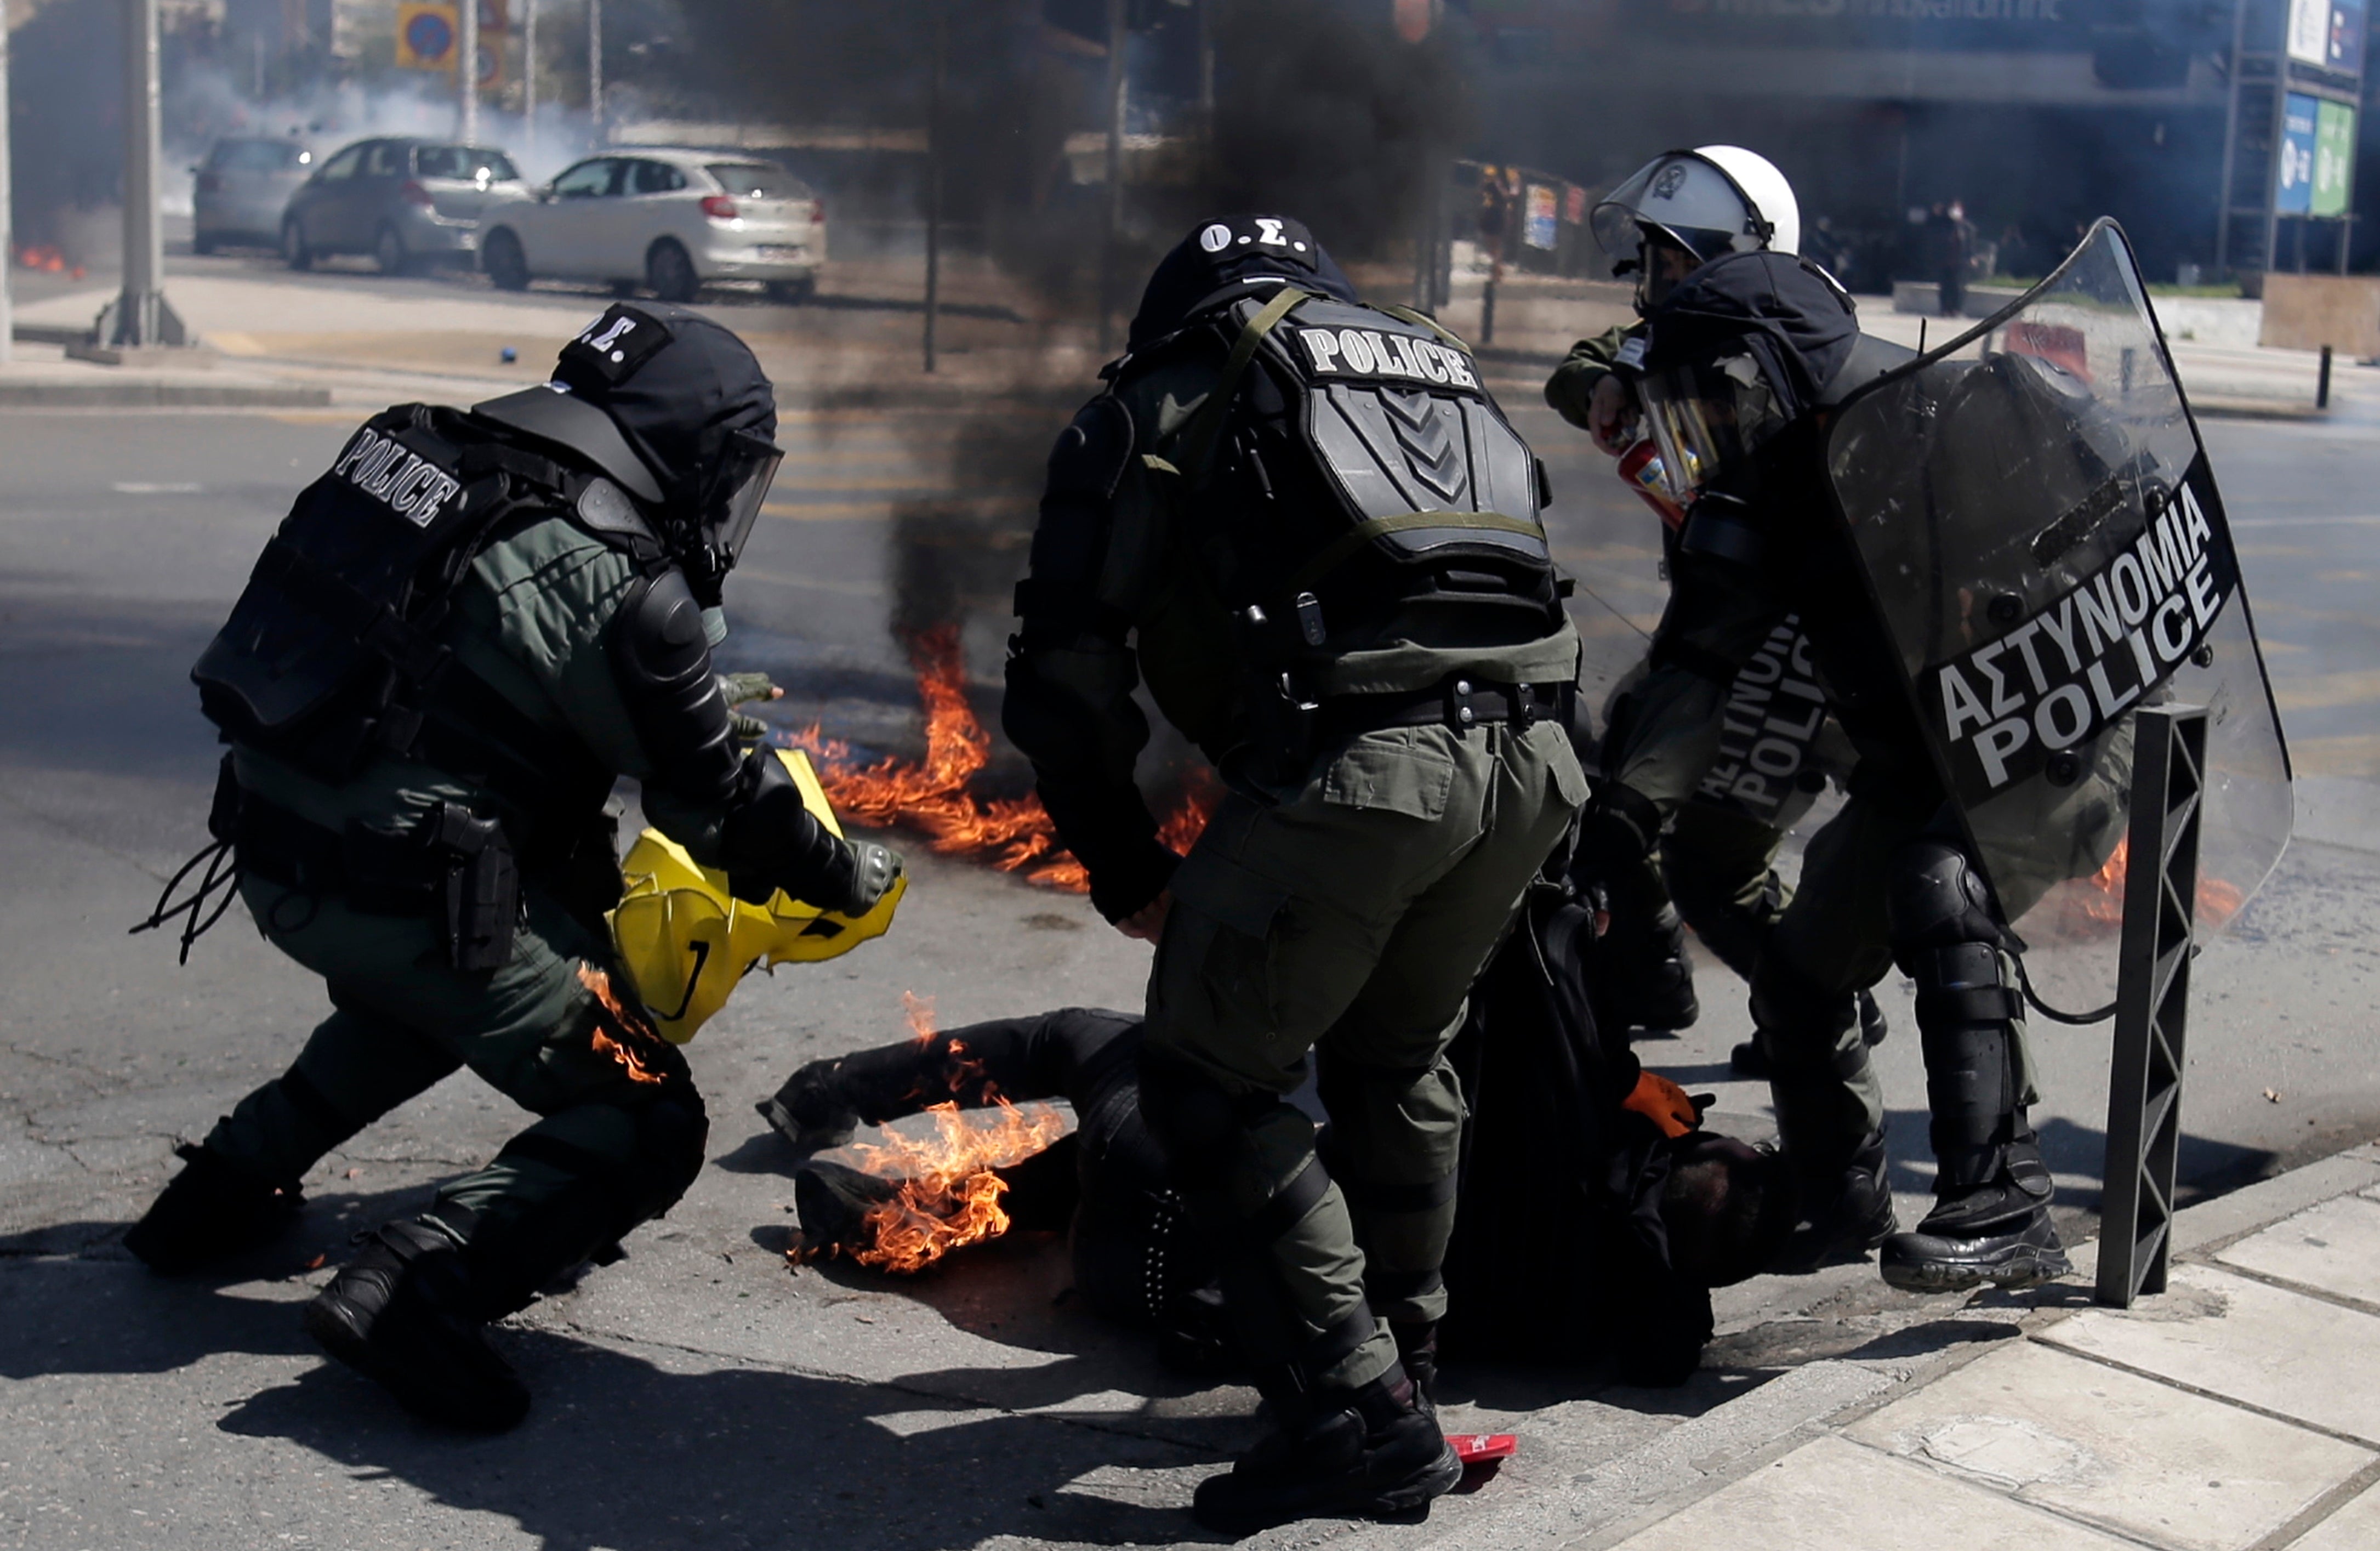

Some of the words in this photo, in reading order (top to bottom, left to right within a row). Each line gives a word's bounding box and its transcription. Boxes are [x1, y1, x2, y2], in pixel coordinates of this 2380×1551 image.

[1300, 328, 1478, 389] POLICE
[335, 427, 460, 529] POLICE
[1939, 481, 2211, 742] ΑΣΤΥΝΟΜΙΑ
[1973, 553, 2220, 788] POLICE
